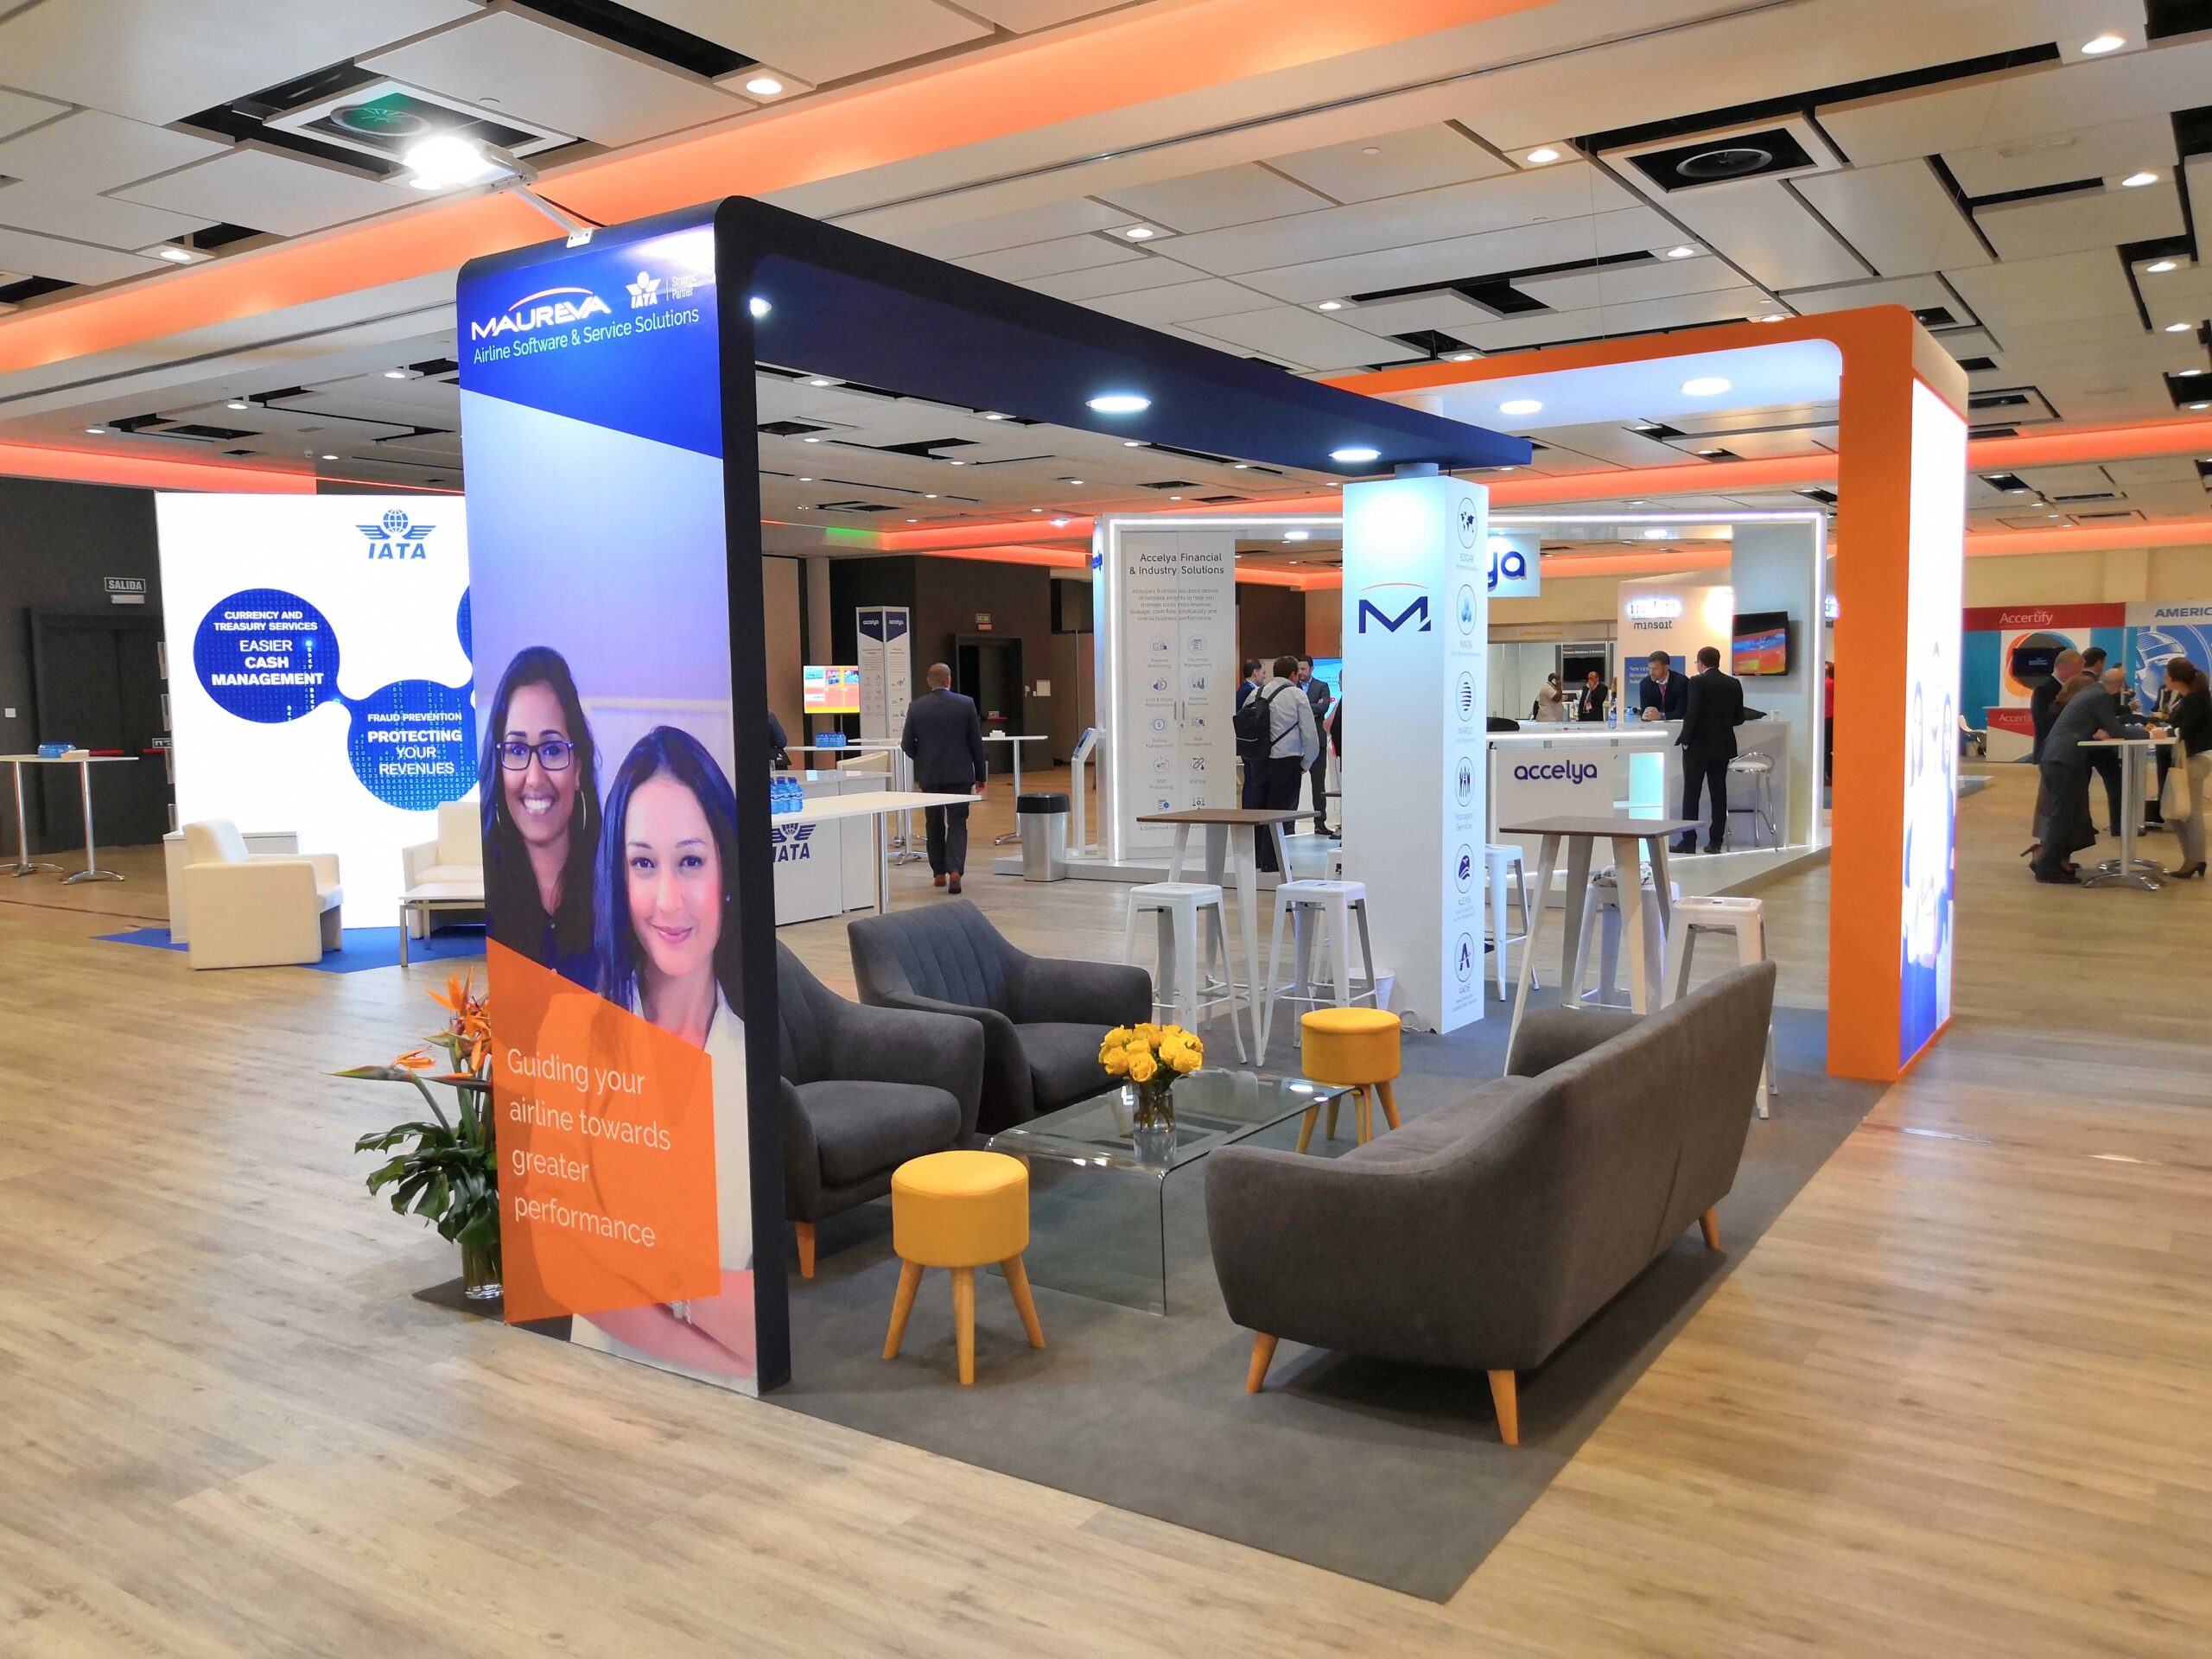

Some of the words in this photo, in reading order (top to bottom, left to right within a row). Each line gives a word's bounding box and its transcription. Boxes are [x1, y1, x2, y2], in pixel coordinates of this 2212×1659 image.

[631, 291, 658, 308] IATA
[471, 296, 612, 340] MAUREVA
[474, 345, 511, 364] Airline
[513, 334, 569, 356] Software
[571, 329, 581, 346] &
[583, 321, 632, 343] Service
[635, 308, 699, 333] Solutions
[368, 543, 426, 559] IATA
[1141, 553, 1177, 563] Accelya
[1180, 553, 1222, 562] Financial
[1129, 566, 1135, 575] &
[1139, 566, 1177, 575] Industry
[108, 580, 143, 590] SALIDA
[224, 611, 279, 620] CURRENCY
[281, 611, 302, 620] AND
[1999, 610, 2054, 625] Accertify
[2154, 607, 2212, 618] AMERIC
[213, 622, 267, 631] TREASURY
[269, 622, 318, 631] SERVICES
[239, 639, 293, 652] EASIER
[245, 657, 289, 669] CASH
[212, 672, 324, 685] MANAGEMENT
[367, 714, 400, 722] FRAUD
[403, 713, 462, 721] PREVENTION
[367, 729, 462, 743] PROTECTING
[396, 746, 436, 758] YOUR
[379, 762, 454, 775] REVENUES
[1514, 760, 1598, 785] accelya
[772, 842, 810, 862] IATA
[507, 1048, 588, 1092] Guiding
[594, 1068, 645, 1095] your
[510, 1097, 573, 1131] airline
[579, 1109, 671, 1150] towards
[512, 1149, 589, 1182] greater
[515, 1196, 656, 1247] performance
